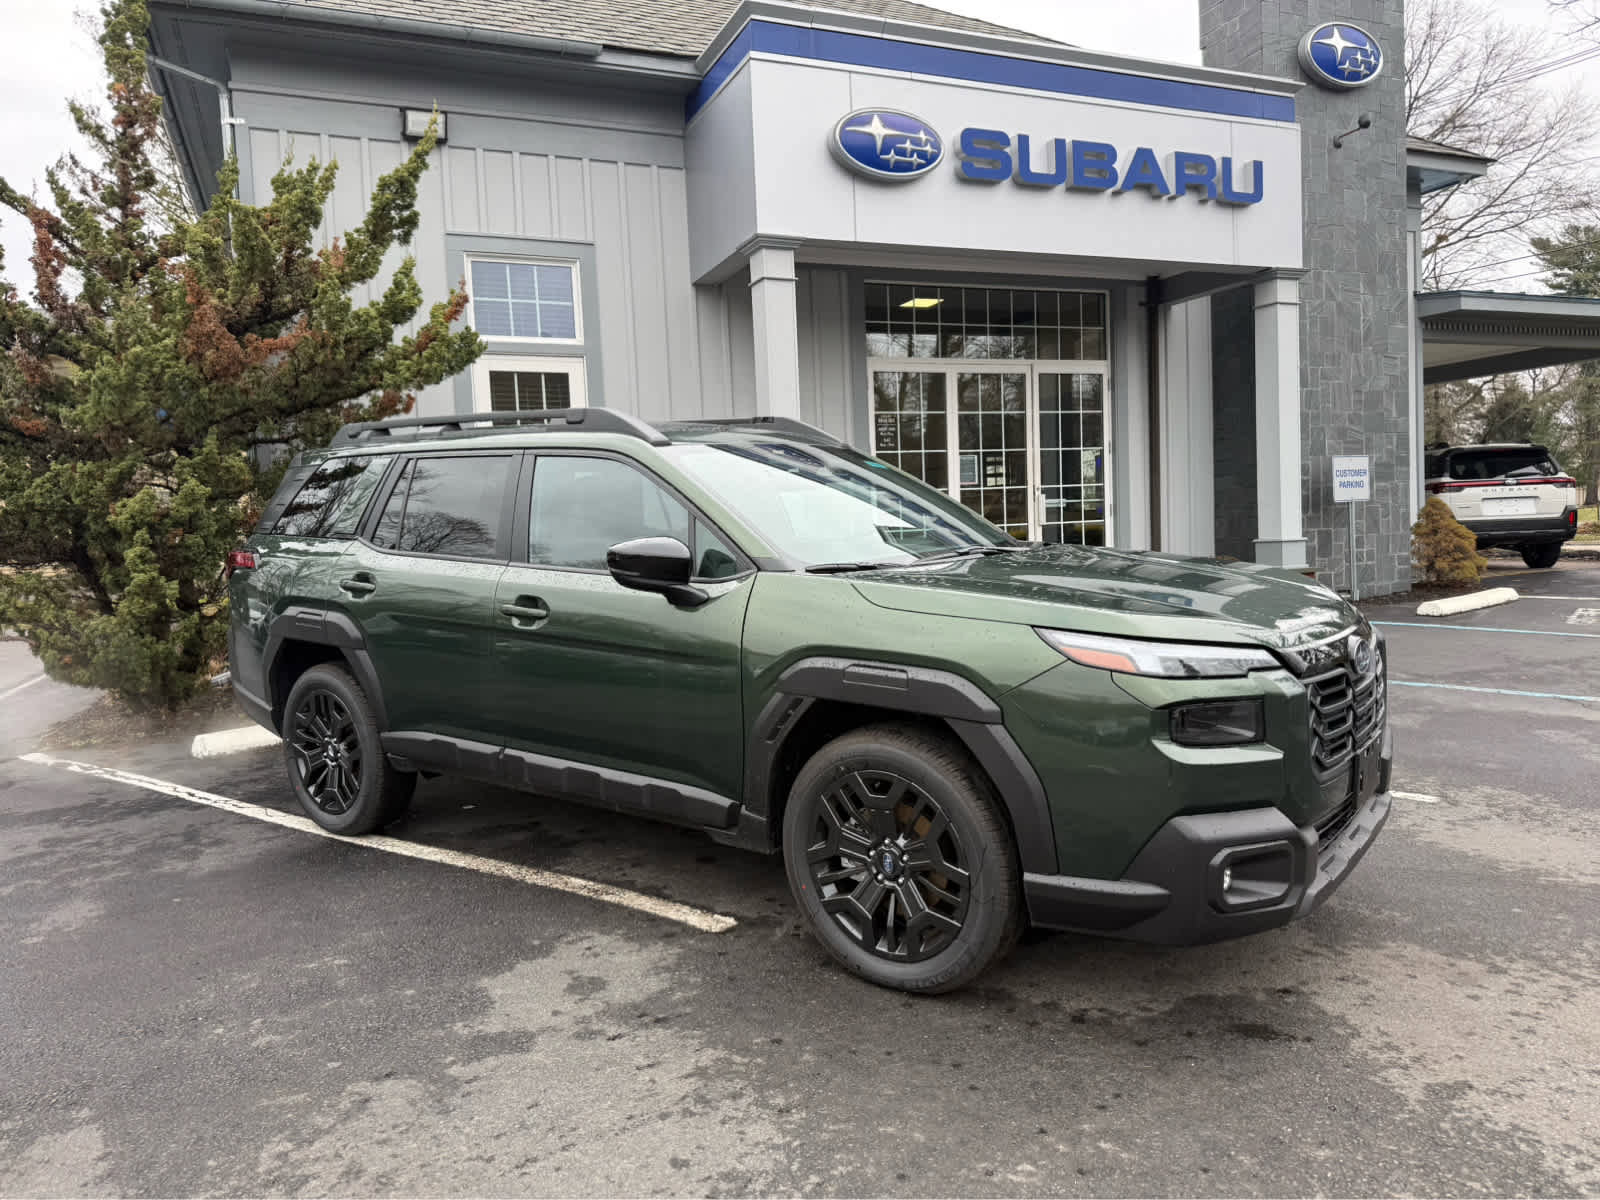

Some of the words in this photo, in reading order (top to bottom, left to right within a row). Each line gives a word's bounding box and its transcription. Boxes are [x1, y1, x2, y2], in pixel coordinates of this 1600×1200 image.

[956, 127, 1264, 206] SUBARU
[1335, 469, 1367, 478] CUSTOMER
[1338, 480, 1365, 489] PARKING
